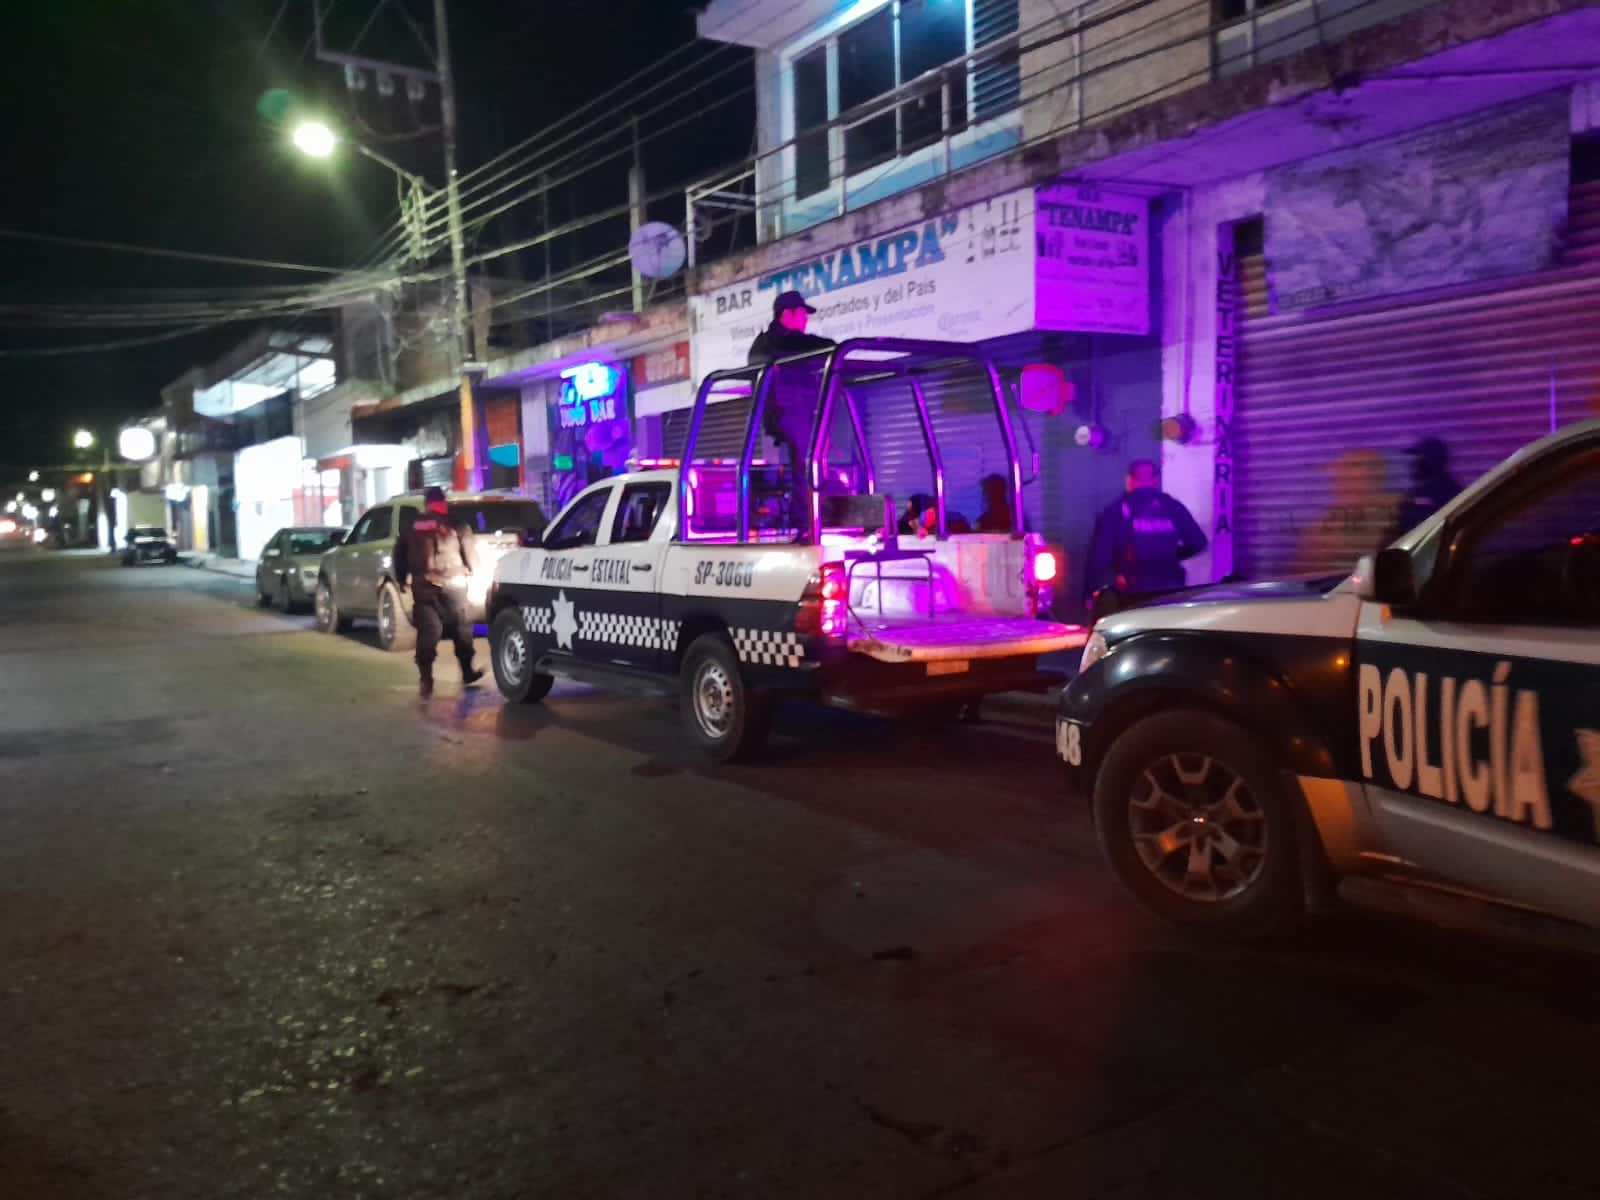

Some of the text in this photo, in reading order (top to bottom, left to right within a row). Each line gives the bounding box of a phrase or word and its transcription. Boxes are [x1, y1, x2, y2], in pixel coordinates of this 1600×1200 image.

[716, 289, 753, 315] BAR
[873, 295, 881, 312] y
[883, 280, 904, 305] del
[1215, 251, 1235, 535] VETERINARIA
[591, 558, 631, 585] ESTATAL
[1358, 661, 1554, 829] POLICÍA
